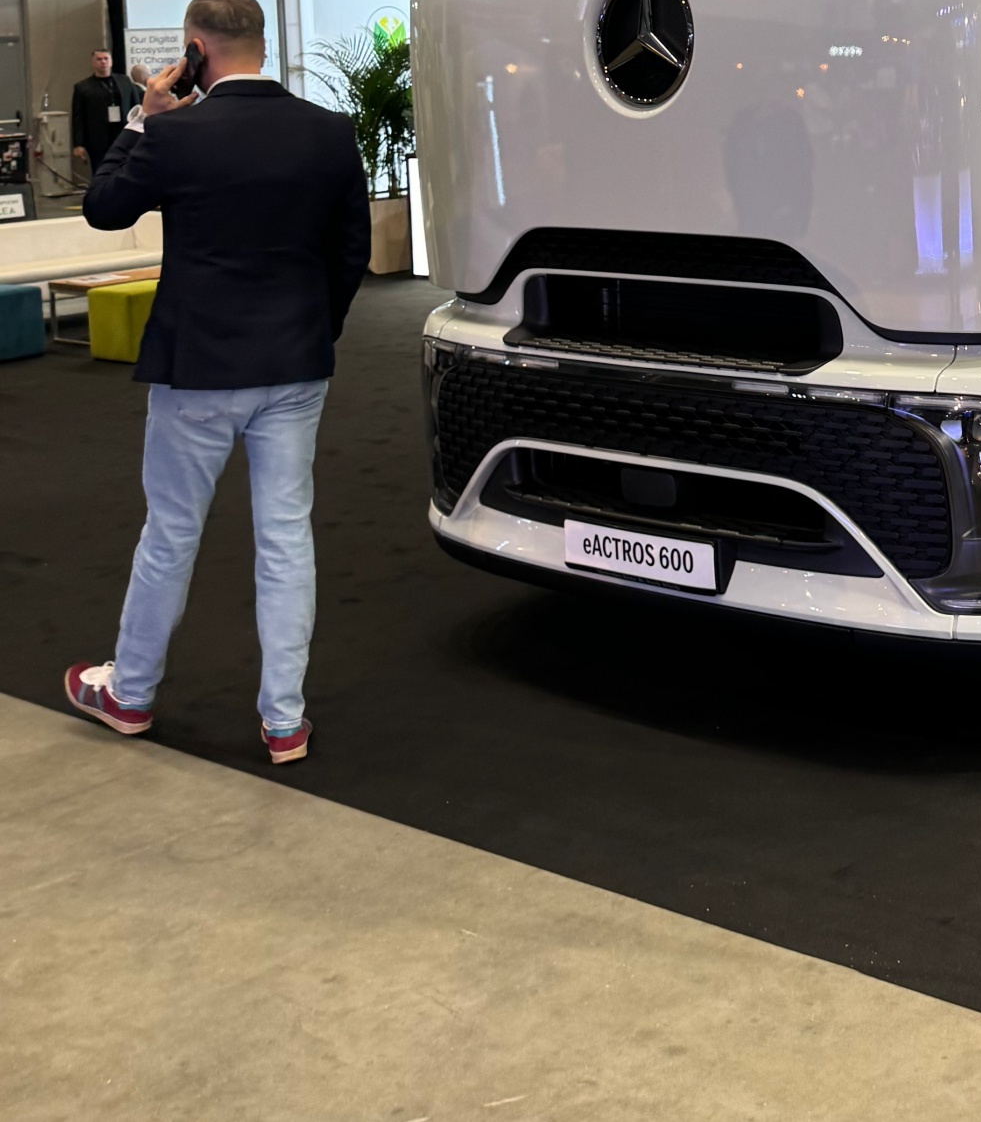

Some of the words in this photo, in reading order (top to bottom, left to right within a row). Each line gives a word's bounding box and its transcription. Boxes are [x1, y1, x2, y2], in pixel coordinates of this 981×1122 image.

[130, 36, 146, 44] Our
[149, 35, 179, 45] Digital
[130, 46, 180, 55] Ecosystem
[583, 533, 655, 567] eACTROS
[659, 546, 694, 574] 600
